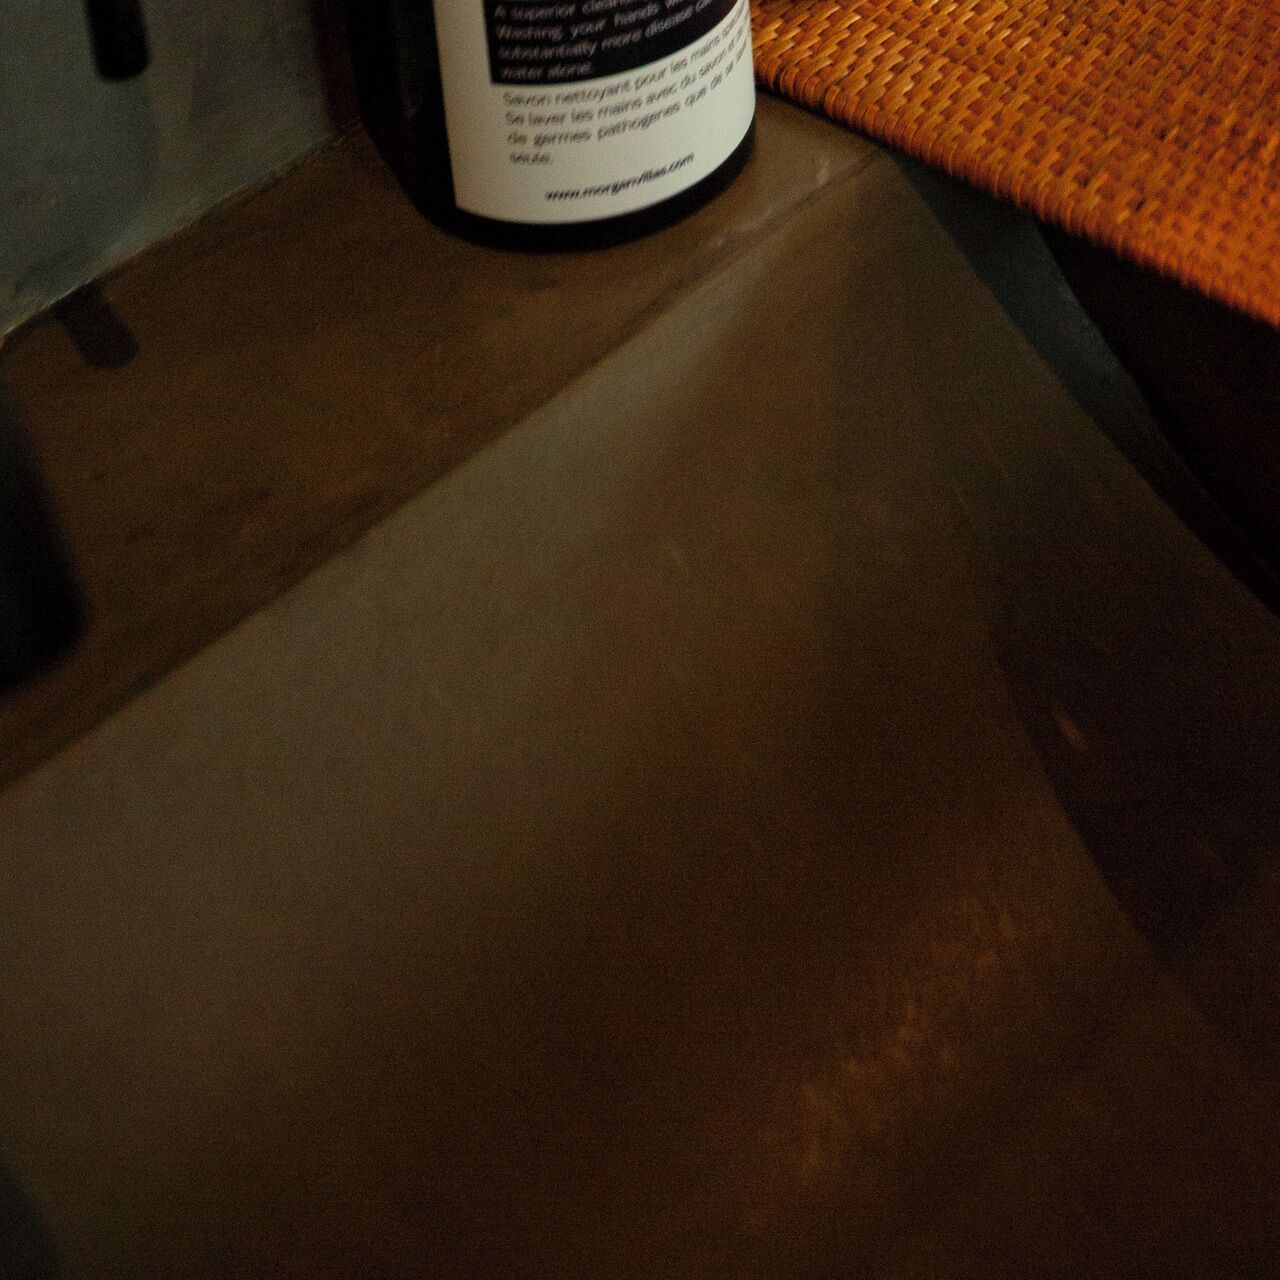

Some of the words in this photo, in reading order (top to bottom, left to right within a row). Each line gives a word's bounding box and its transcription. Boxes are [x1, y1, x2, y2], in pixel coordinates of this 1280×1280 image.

[510, 4, 577, 22] superior
[570, 18, 606, 41] your
[614, 0, 660, 28] hands
[601, 29, 642, 52] more
[645, 4, 694, 39] disease
[634, 66, 668, 92] pour
[670, 57, 690, 75] les
[571, 108, 594, 124] les
[597, 96, 643, 118] mains
[645, 83, 679, 106] avec
[680, 72, 697, 90] du
